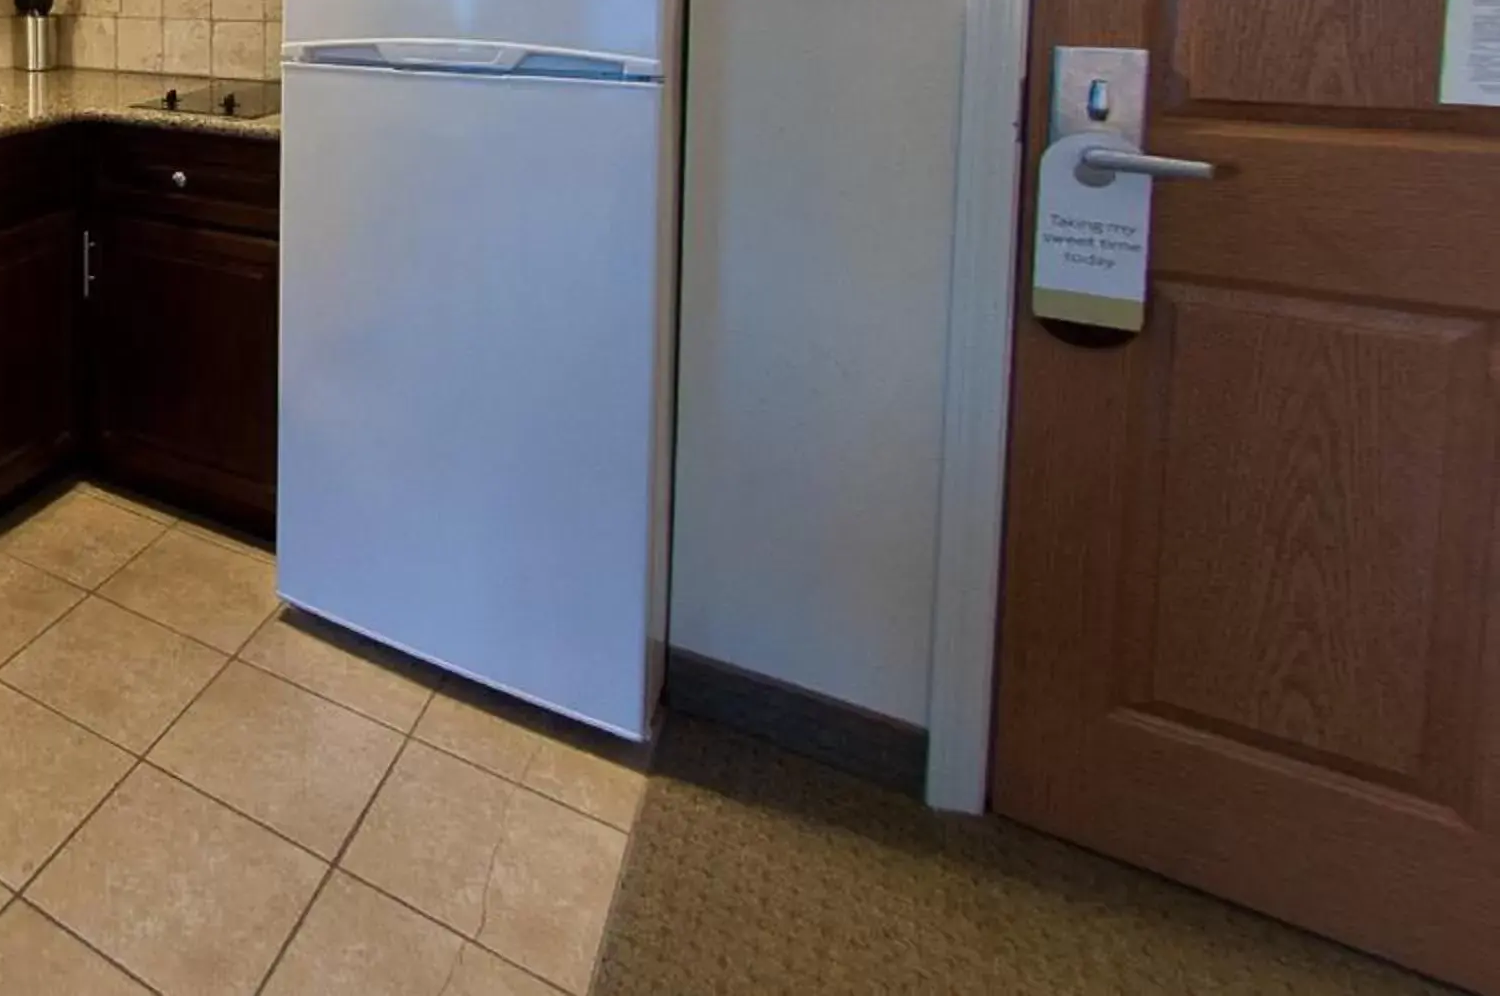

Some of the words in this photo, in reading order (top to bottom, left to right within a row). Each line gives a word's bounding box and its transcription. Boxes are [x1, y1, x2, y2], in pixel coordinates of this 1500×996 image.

[1050, 213, 1103, 235] Taking
[1106, 222, 1136, 238] my
[1042, 232, 1094, 247] sweet
[1099, 238, 1142, 253] time
[1063, 251, 1116, 271] today
